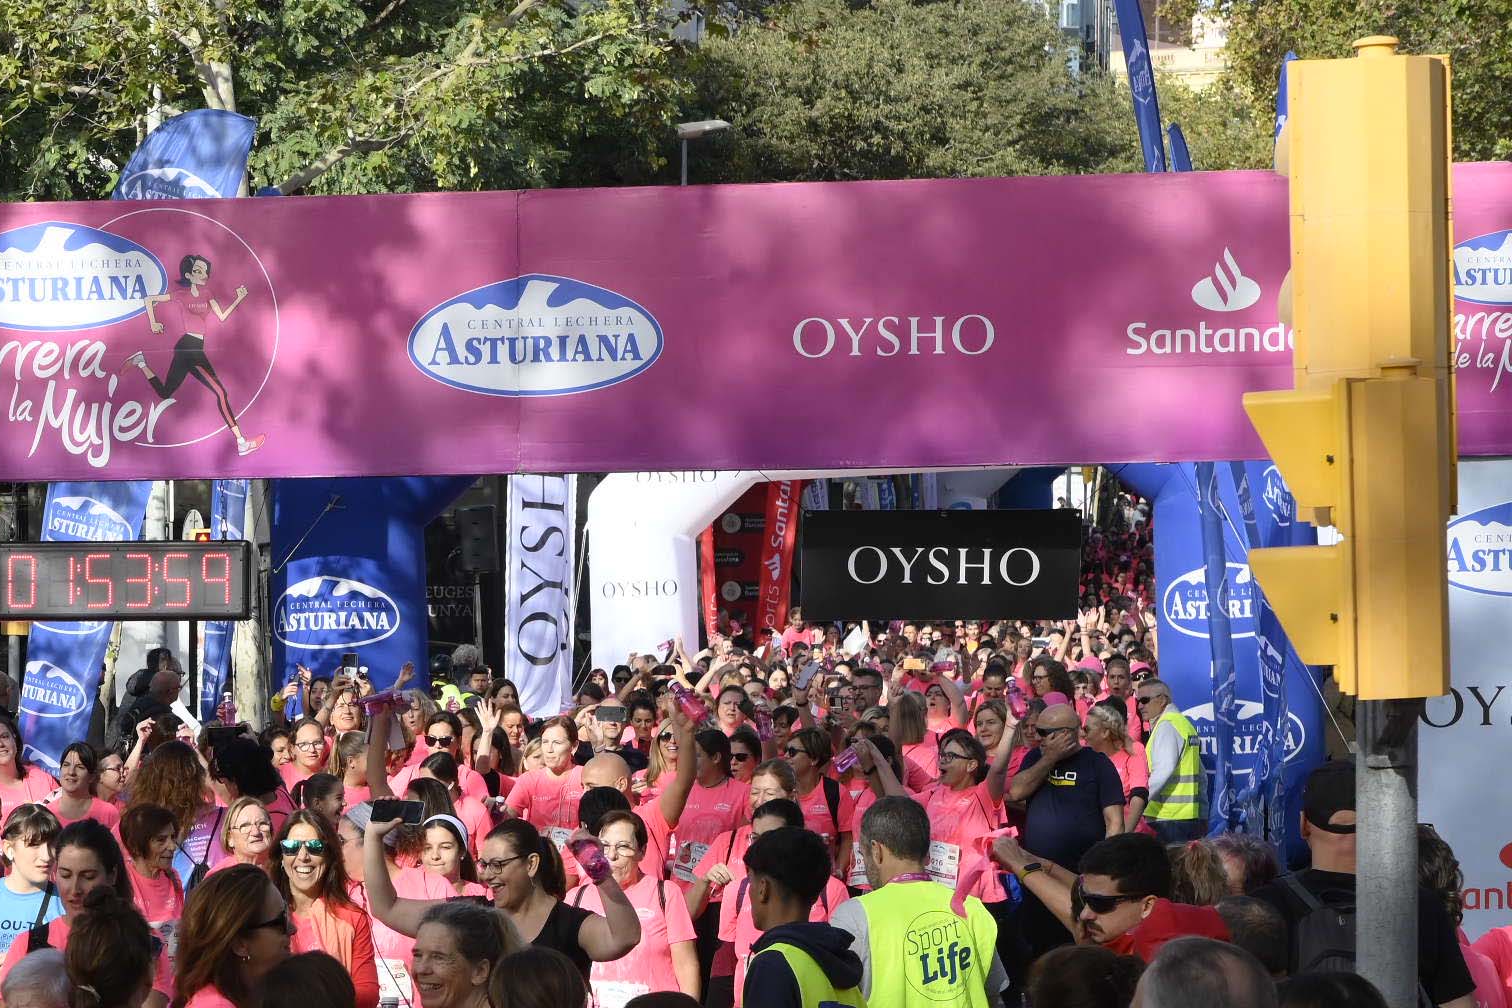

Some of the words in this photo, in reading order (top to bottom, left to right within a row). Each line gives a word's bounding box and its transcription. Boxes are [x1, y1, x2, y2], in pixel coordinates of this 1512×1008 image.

[467, 316, 546, 330] CENTRAL
[553, 315, 634, 328] LECHERA
[792, 313, 996, 358] OYSHO
[1126, 321, 1294, 355] Santand
[428, 322, 643, 367] ASTURIANA
[8, 385, 33, 422] la
[28, 374, 176, 468] Mujer
[517, 474, 568, 666] OYSH
[847, 546, 1041, 587] OYSHO
[290, 600, 332, 610] CENTRAL
[337, 600, 386, 609] LECHERA
[602, 579, 678, 599] OYSHO
[278, 606, 391, 633] ASTURIANA
[906, 917, 961, 957] Sport
[919, 941, 971, 985] Life
